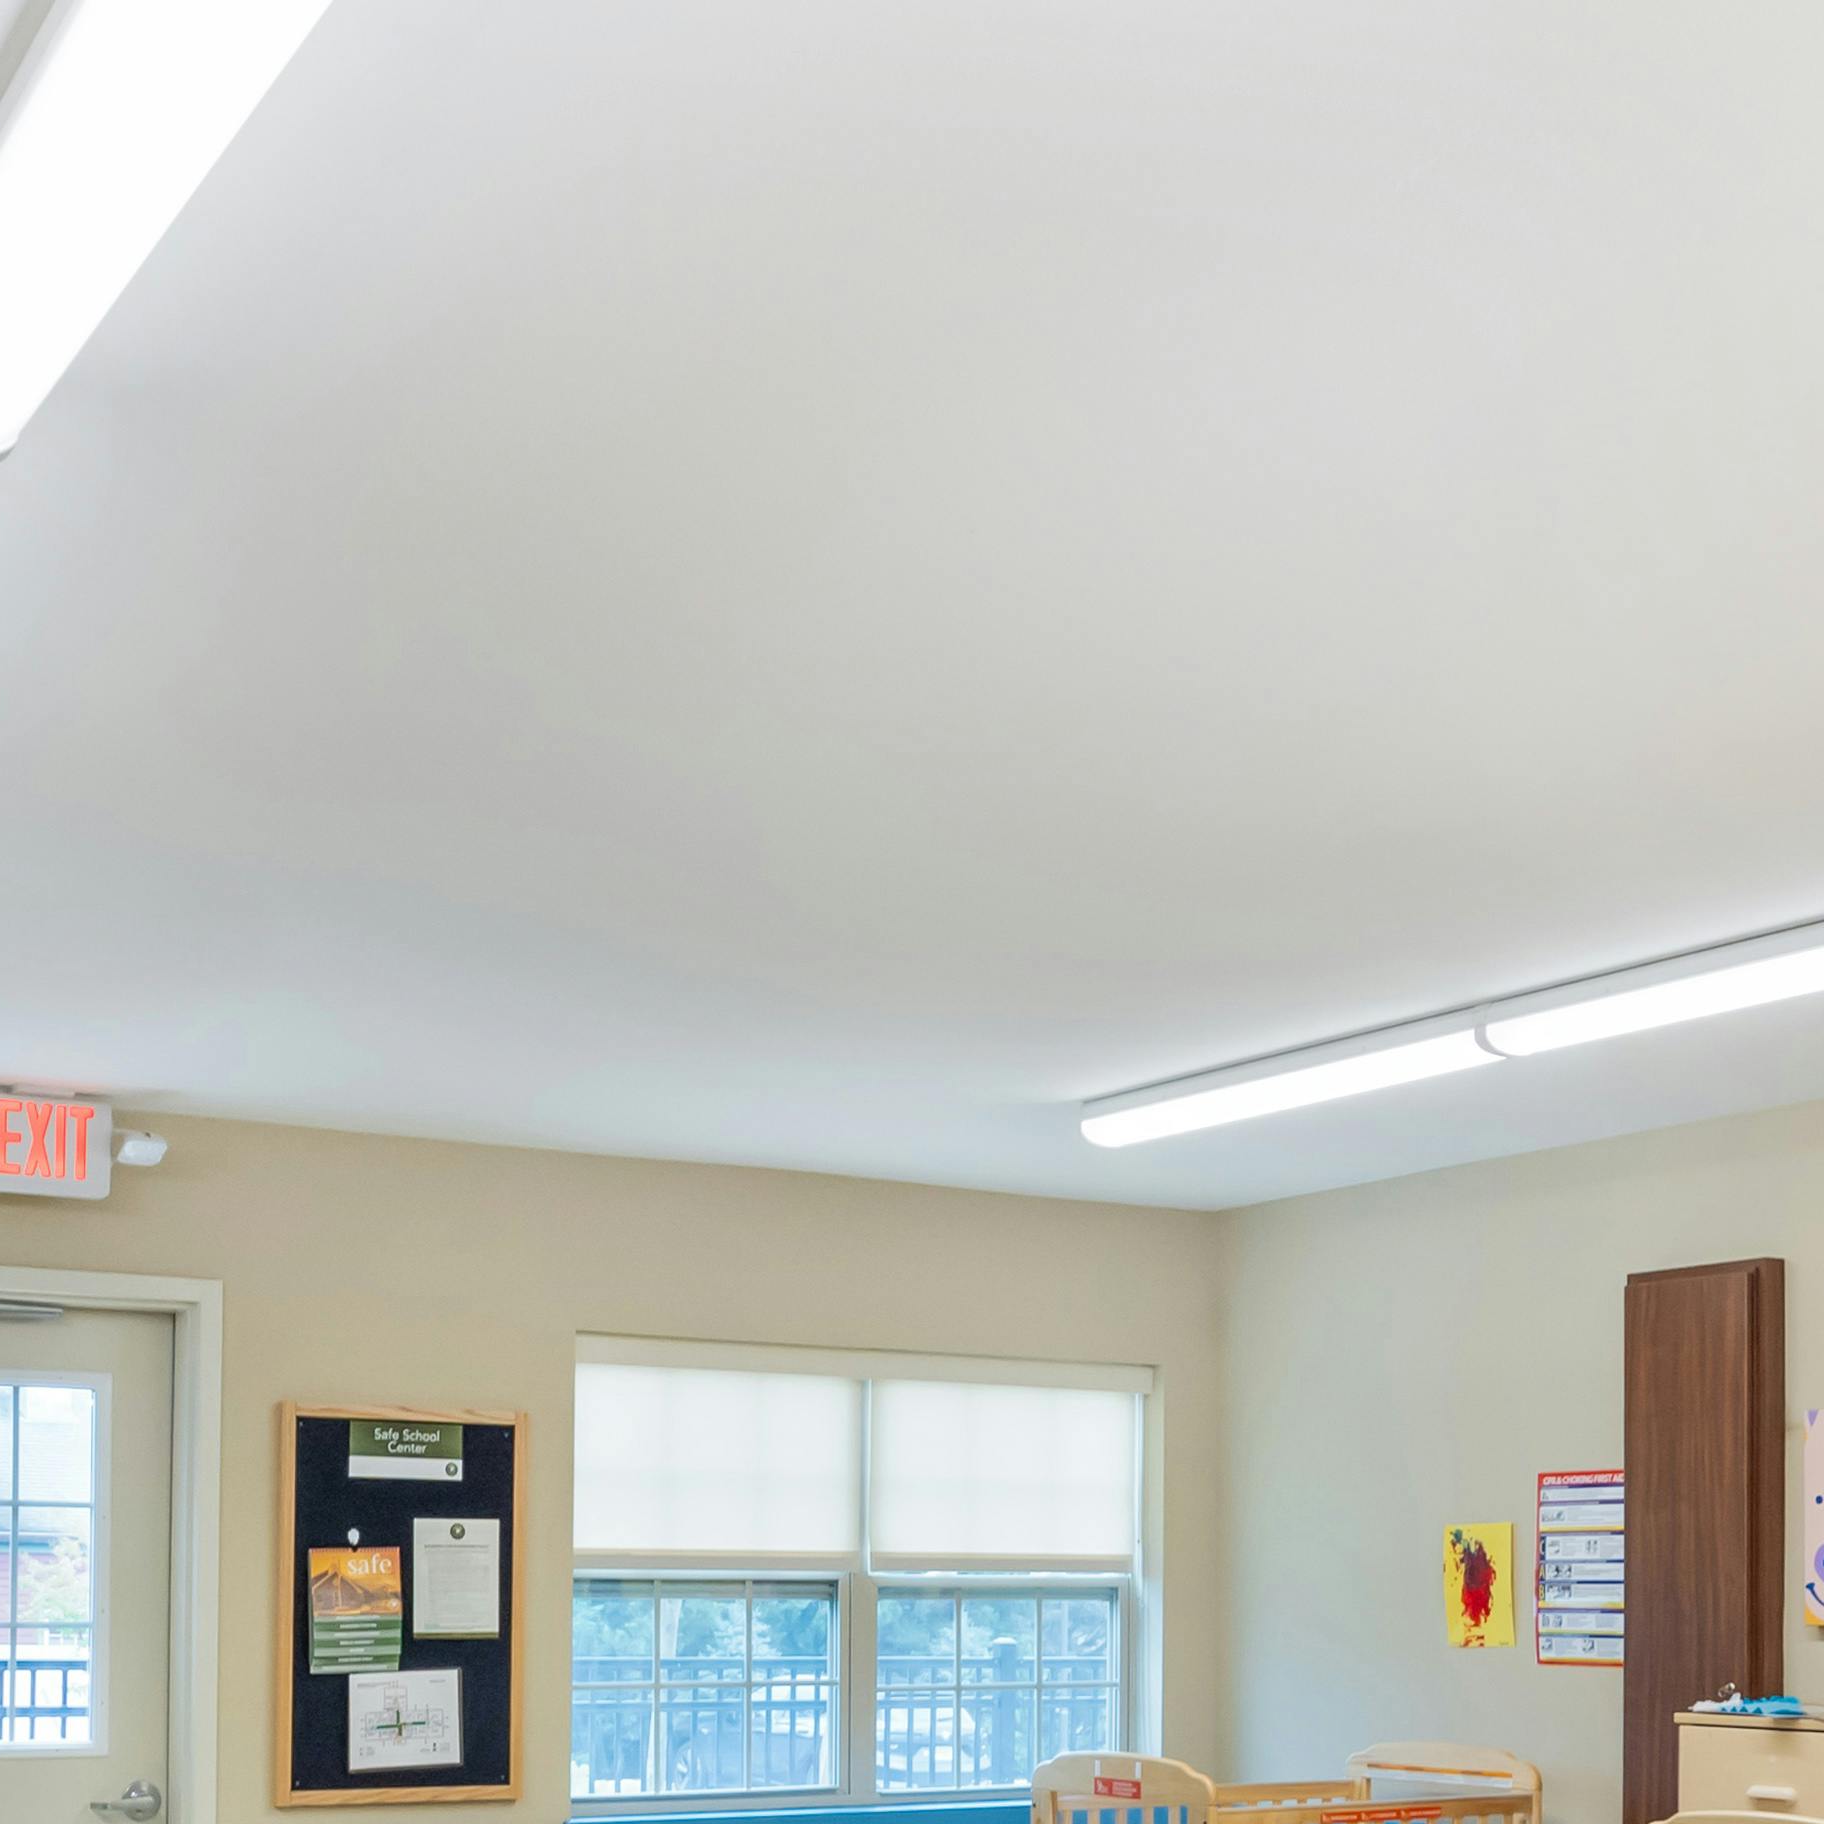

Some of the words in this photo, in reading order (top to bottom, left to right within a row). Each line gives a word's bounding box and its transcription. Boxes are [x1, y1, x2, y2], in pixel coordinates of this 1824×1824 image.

[374, 1427, 400, 1441] Safe
[402, 1428, 441, 1442] School
[387, 1441, 428, 1454] Center
[347, 1553, 392, 1575] safe
